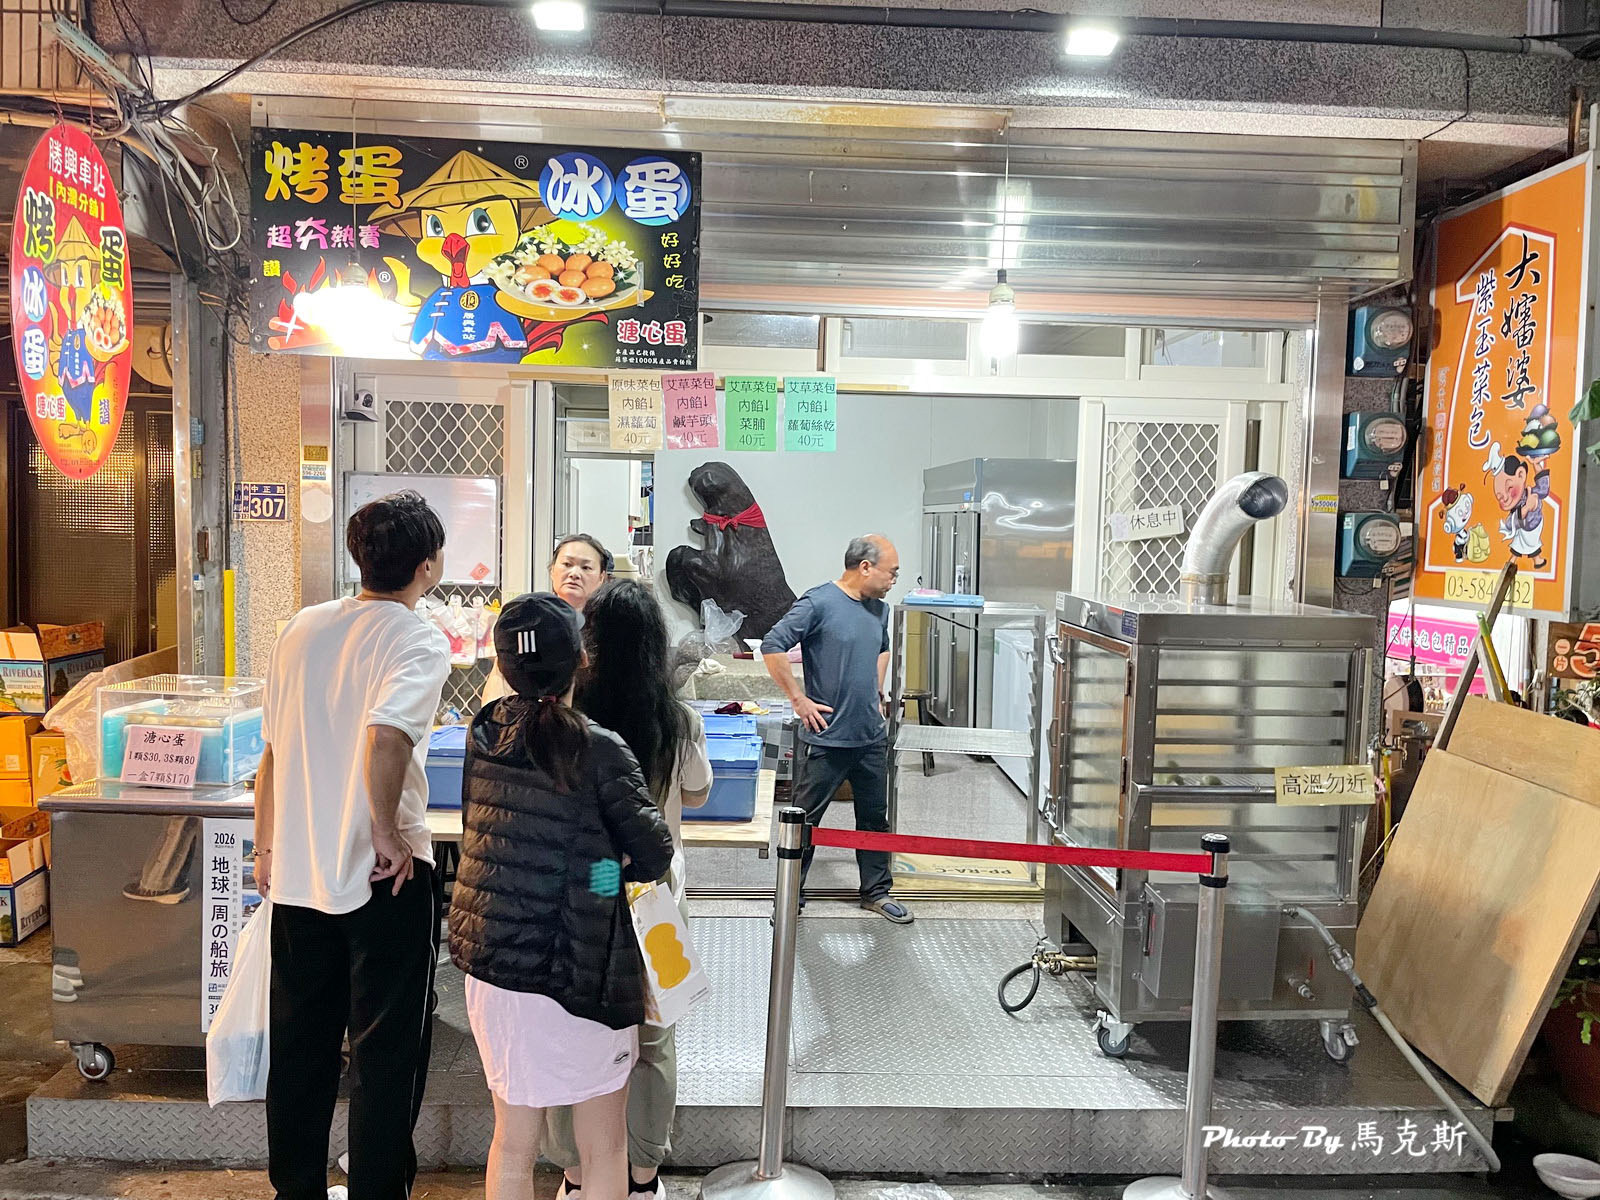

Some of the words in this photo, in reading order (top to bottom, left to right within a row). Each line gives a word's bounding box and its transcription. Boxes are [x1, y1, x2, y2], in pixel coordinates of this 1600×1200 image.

[48, 137, 106, 198] 勝興車站
[264, 141, 404, 208] 烤蛋
[547, 158, 683, 222] 冰蛋
[24, 187, 56, 265] 烤
[267, 217, 381, 250] 超夯熱賣
[99, 225, 126, 294] 蛋
[660, 232, 686, 290] 好好吃
[1501, 233, 1541, 410] 大嬸婆
[616, 318, 687, 347] 溏心蛋
[1468, 268, 1497, 450] 紫玉菜包
[611, 378, 661, 392] 原味菜包
[665, 377, 715, 390] 艾草菜包
[728, 380, 777, 394] 艾草菜包
[787, 381, 836, 394] 艾草菜包
[622, 397, 648, 411] 內餡
[676, 395, 702, 410] 內餡
[738, 399, 764, 412] 內餡
[797, 399, 823, 413] 內餡
[623, 432, 651, 446] 40元
[739, 433, 765, 447] 40元
[797, 433, 824, 447] 40元
[250, 497, 285, 518] 307
[1129, 510, 1178, 531] 休息中
[1447, 576, 1531, 604] 03-584232
[214, 832, 236, 845] 2026
[209, 856, 231, 978] 地球一周の船旅
